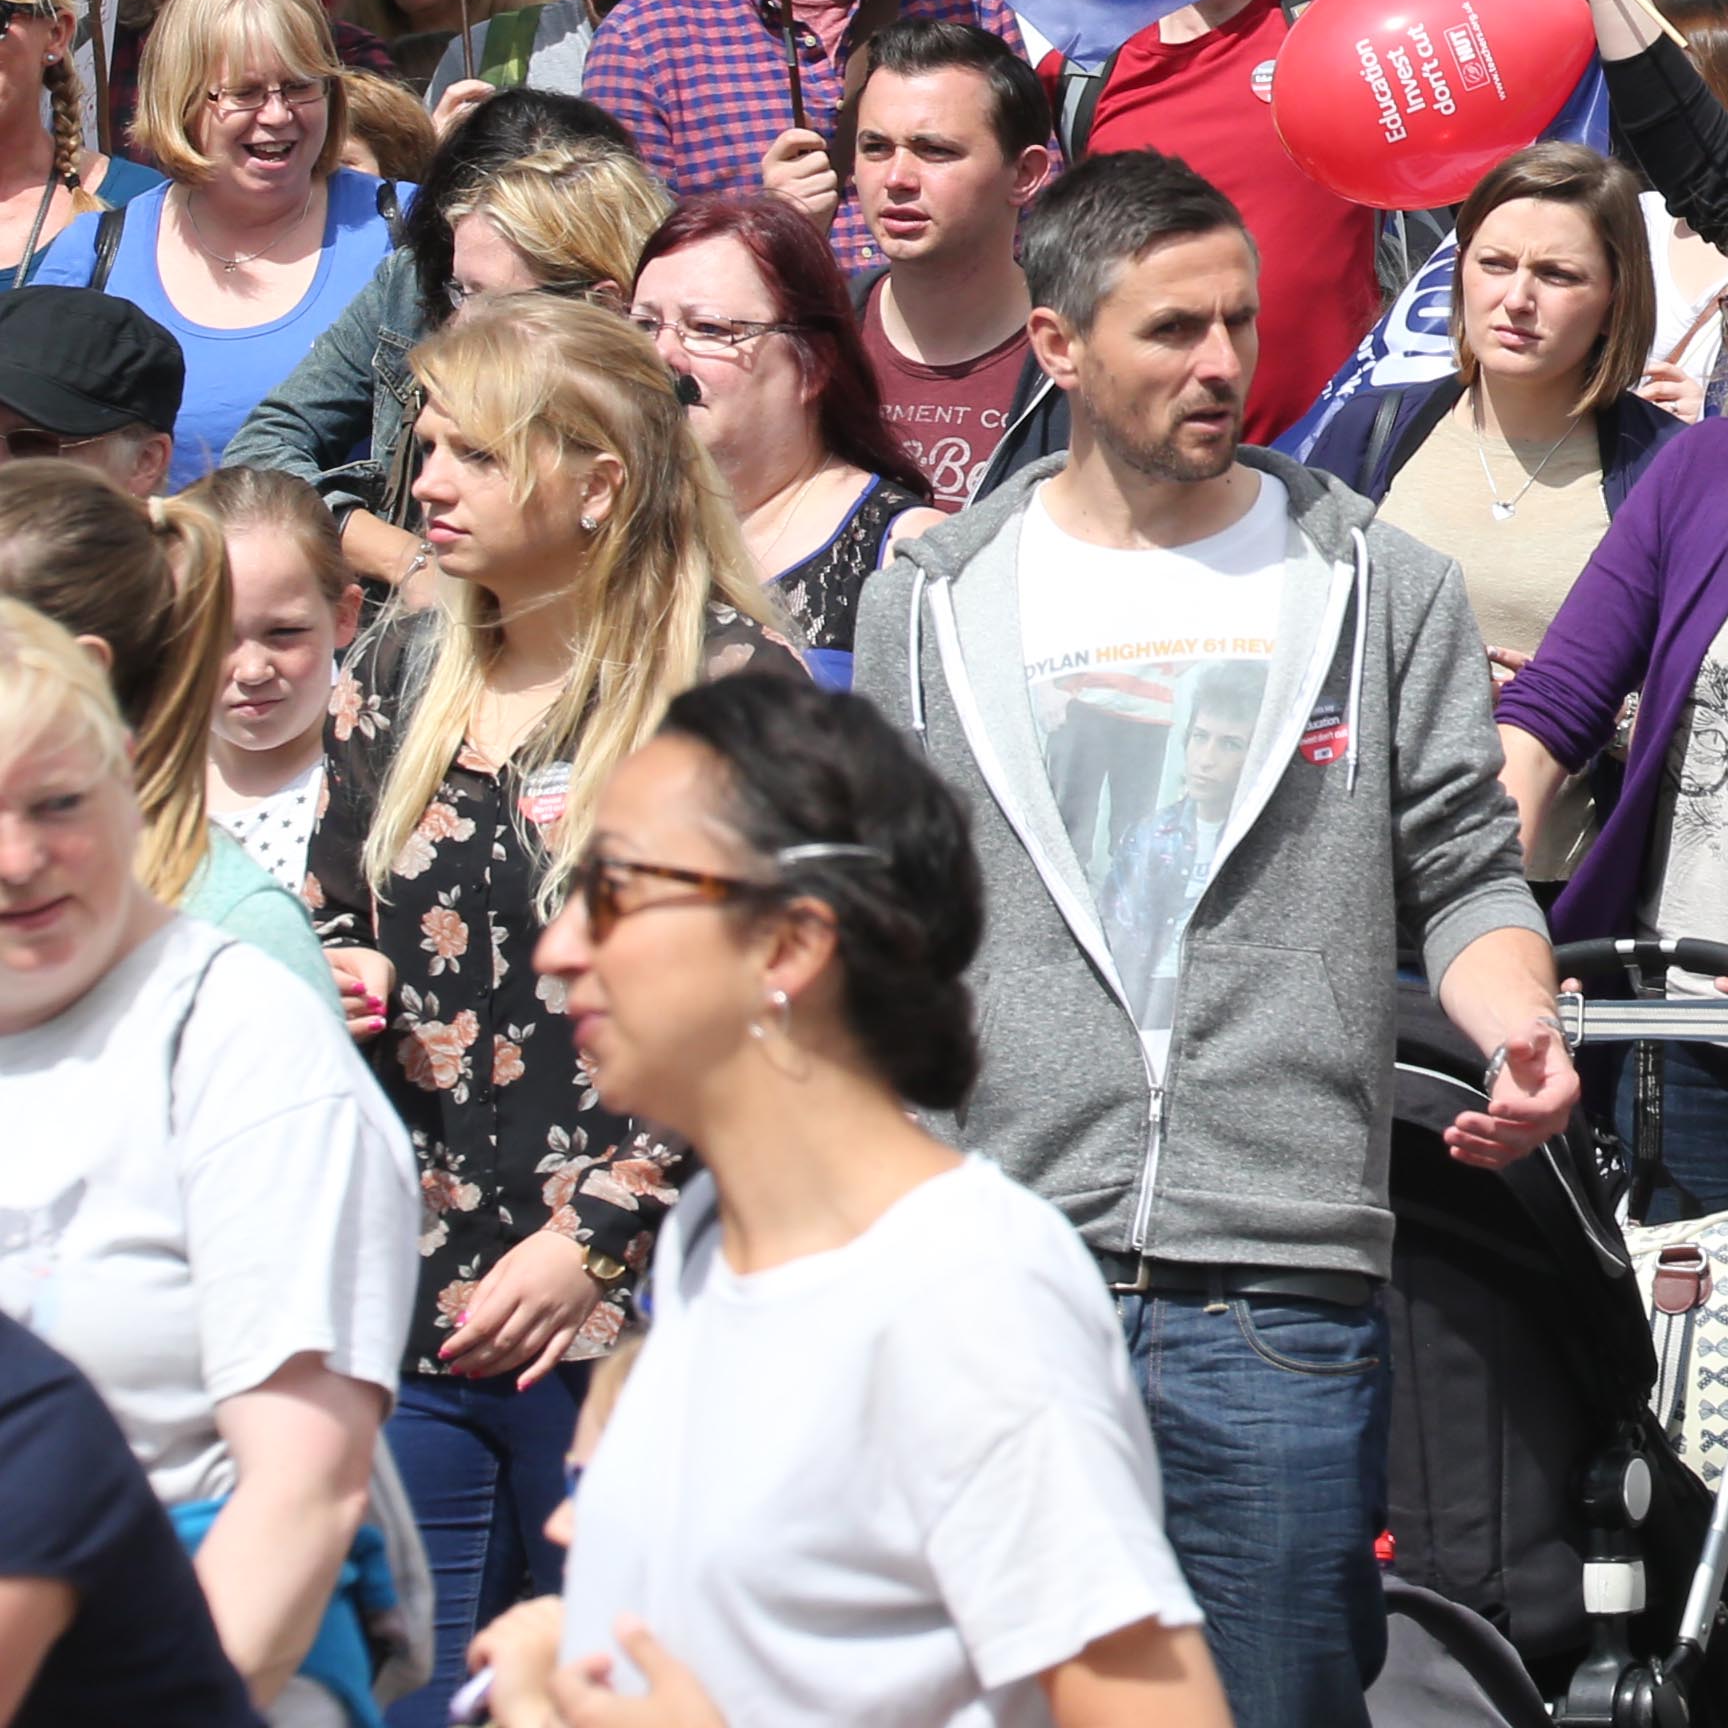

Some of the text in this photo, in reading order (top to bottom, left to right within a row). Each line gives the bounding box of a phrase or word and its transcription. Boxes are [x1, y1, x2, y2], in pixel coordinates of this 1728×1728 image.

[1407, 22, 1435, 60] cut
[1449, 30, 1476, 64] NUT
[1355, 38, 1407, 144] Education
[1386, 46, 1427, 114] Invest
[1096, 639, 1198, 663] HIGHWAY
[1203, 638, 1226, 654] 61
[1232, 638, 1275, 654] REV
